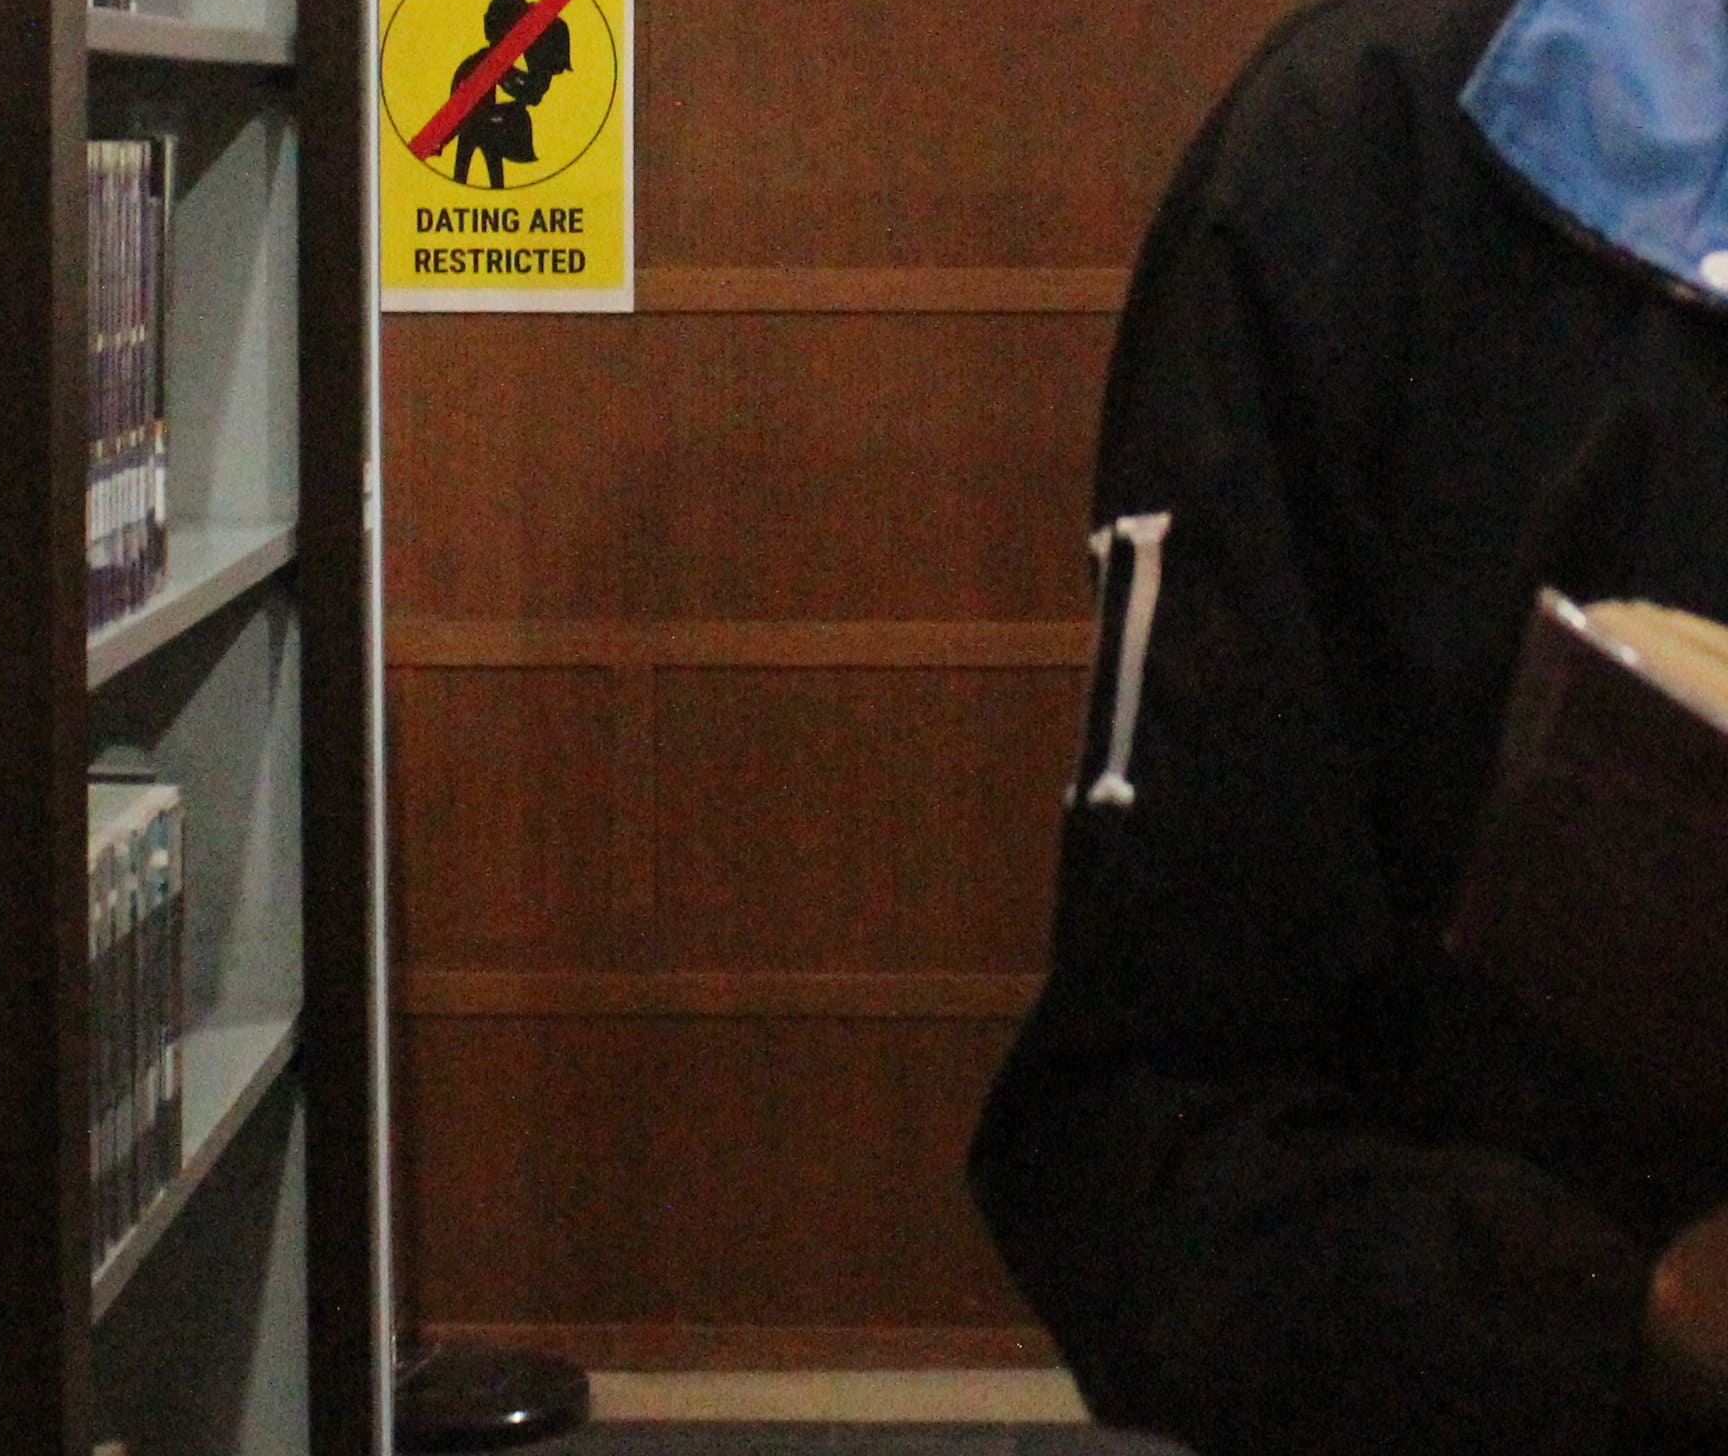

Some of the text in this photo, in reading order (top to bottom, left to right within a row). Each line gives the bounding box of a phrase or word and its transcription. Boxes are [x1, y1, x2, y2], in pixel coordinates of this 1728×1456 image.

[416, 208, 584, 233] DATING ARE
[414, 248, 586, 274] RESTRICTED
